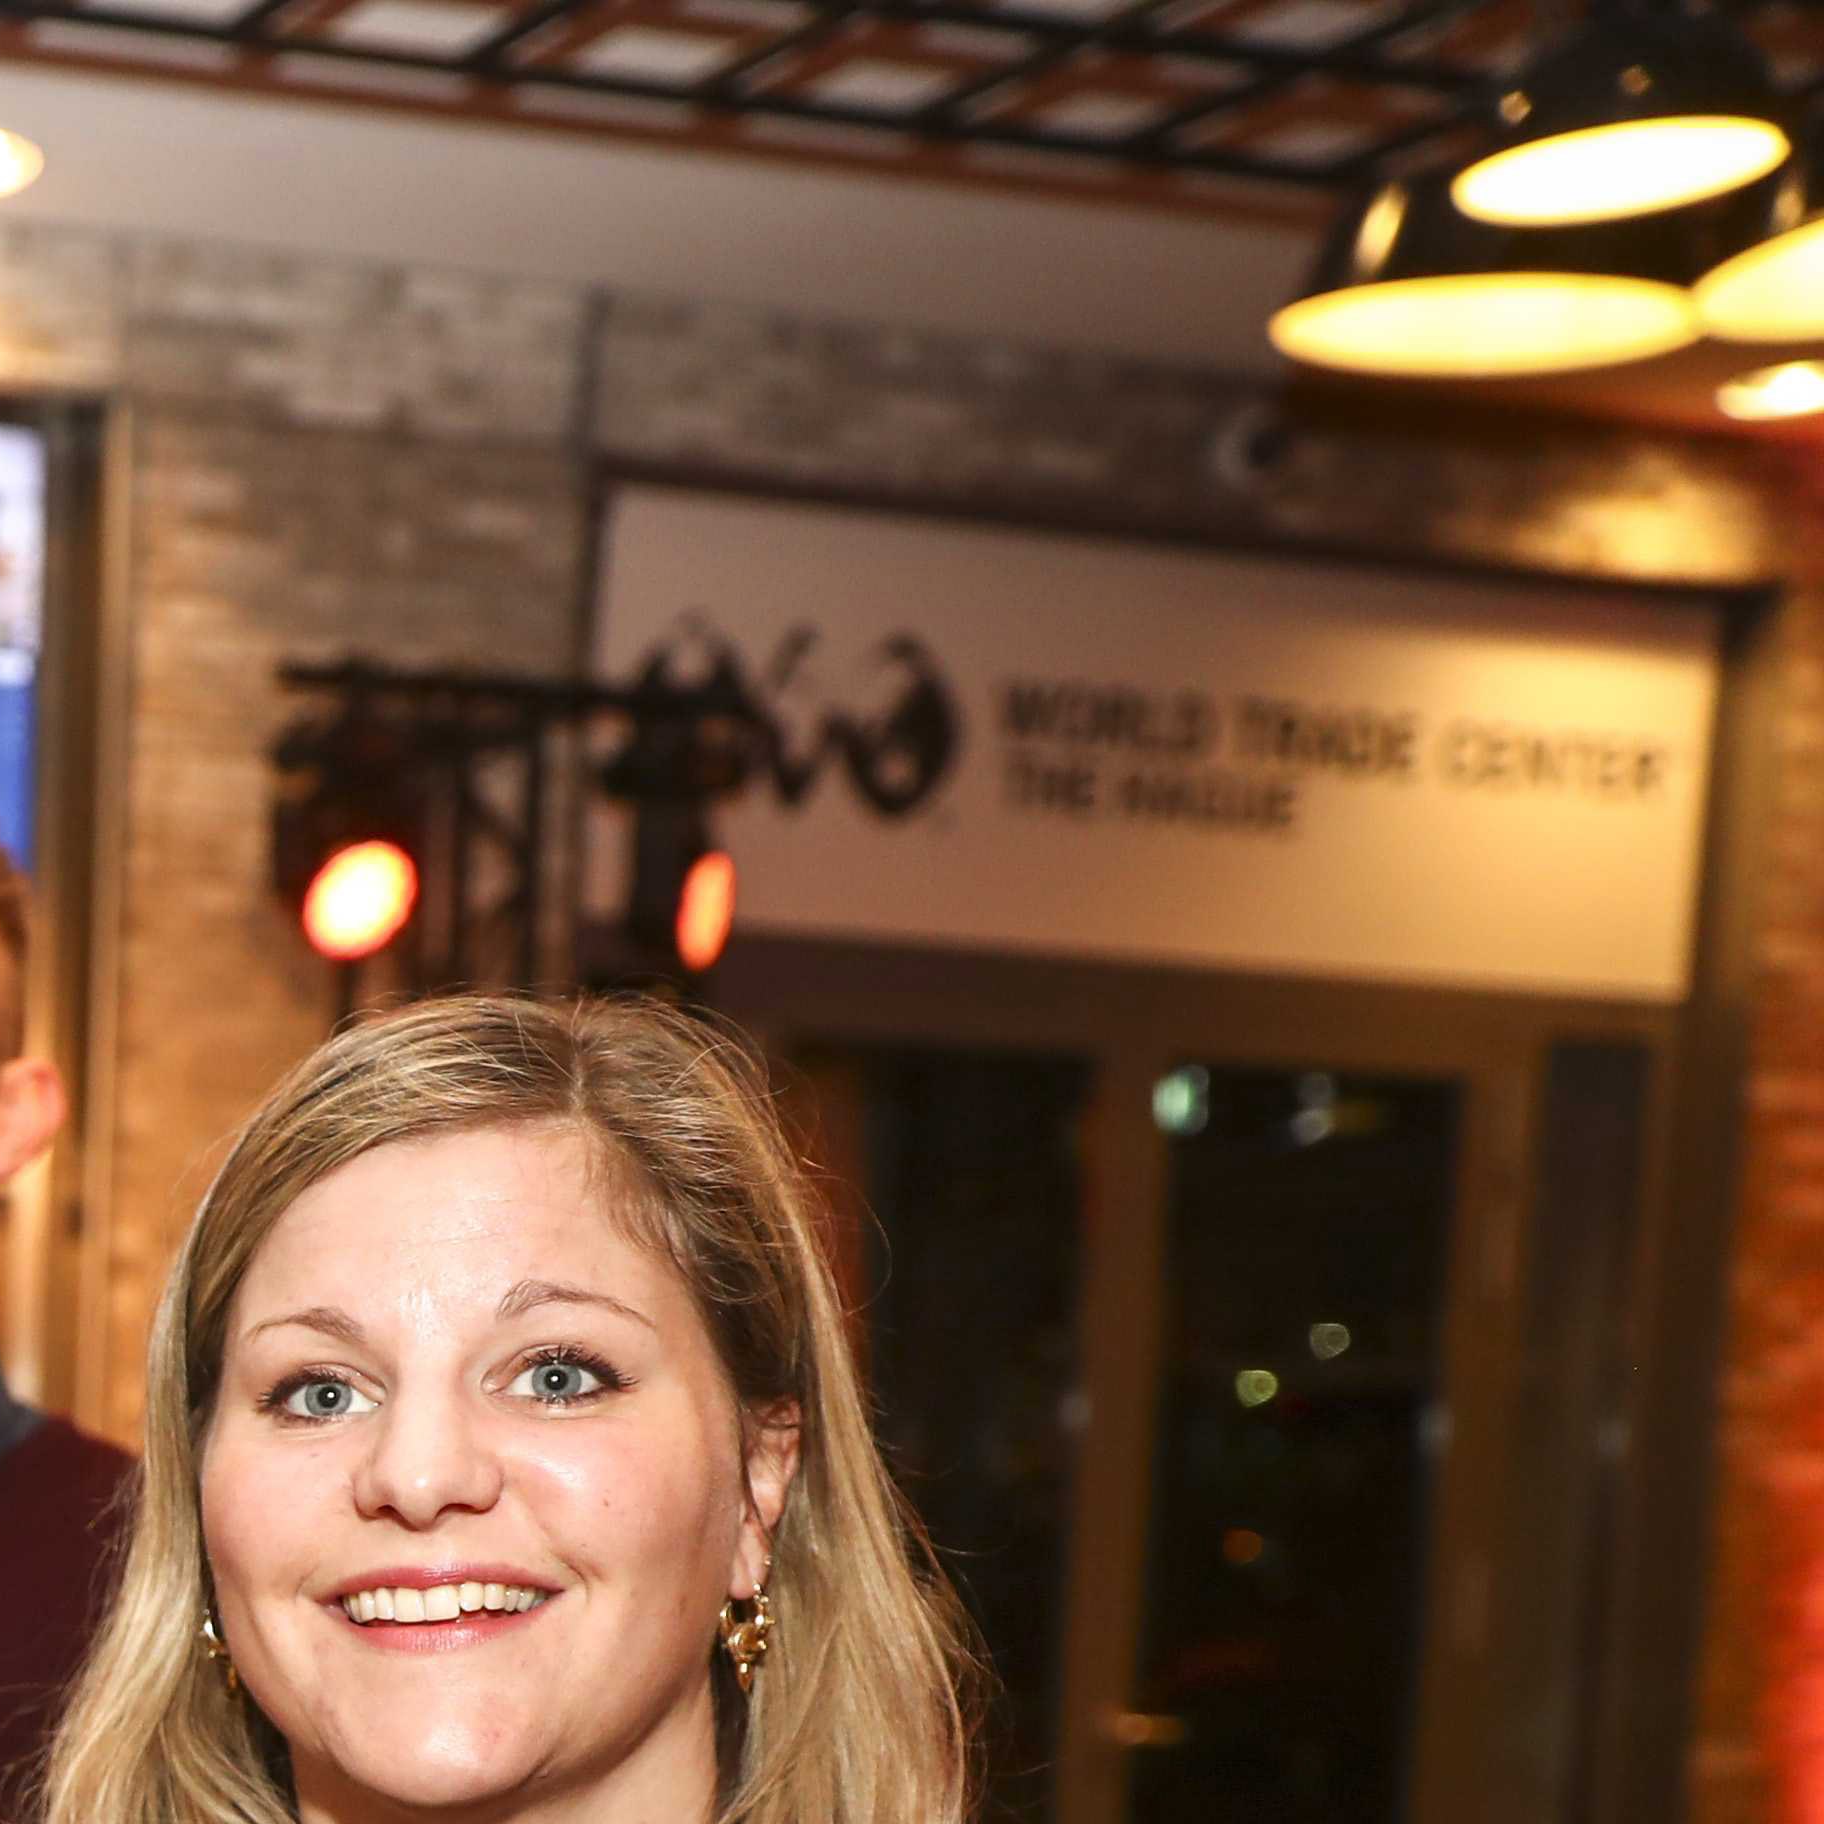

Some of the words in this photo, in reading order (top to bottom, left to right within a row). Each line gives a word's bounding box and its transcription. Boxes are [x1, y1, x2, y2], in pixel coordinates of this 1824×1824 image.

[1002, 680, 1215, 755] WORLD
[1238, 694, 1418, 780] TRADE
[1438, 718, 1666, 796] CENTER
